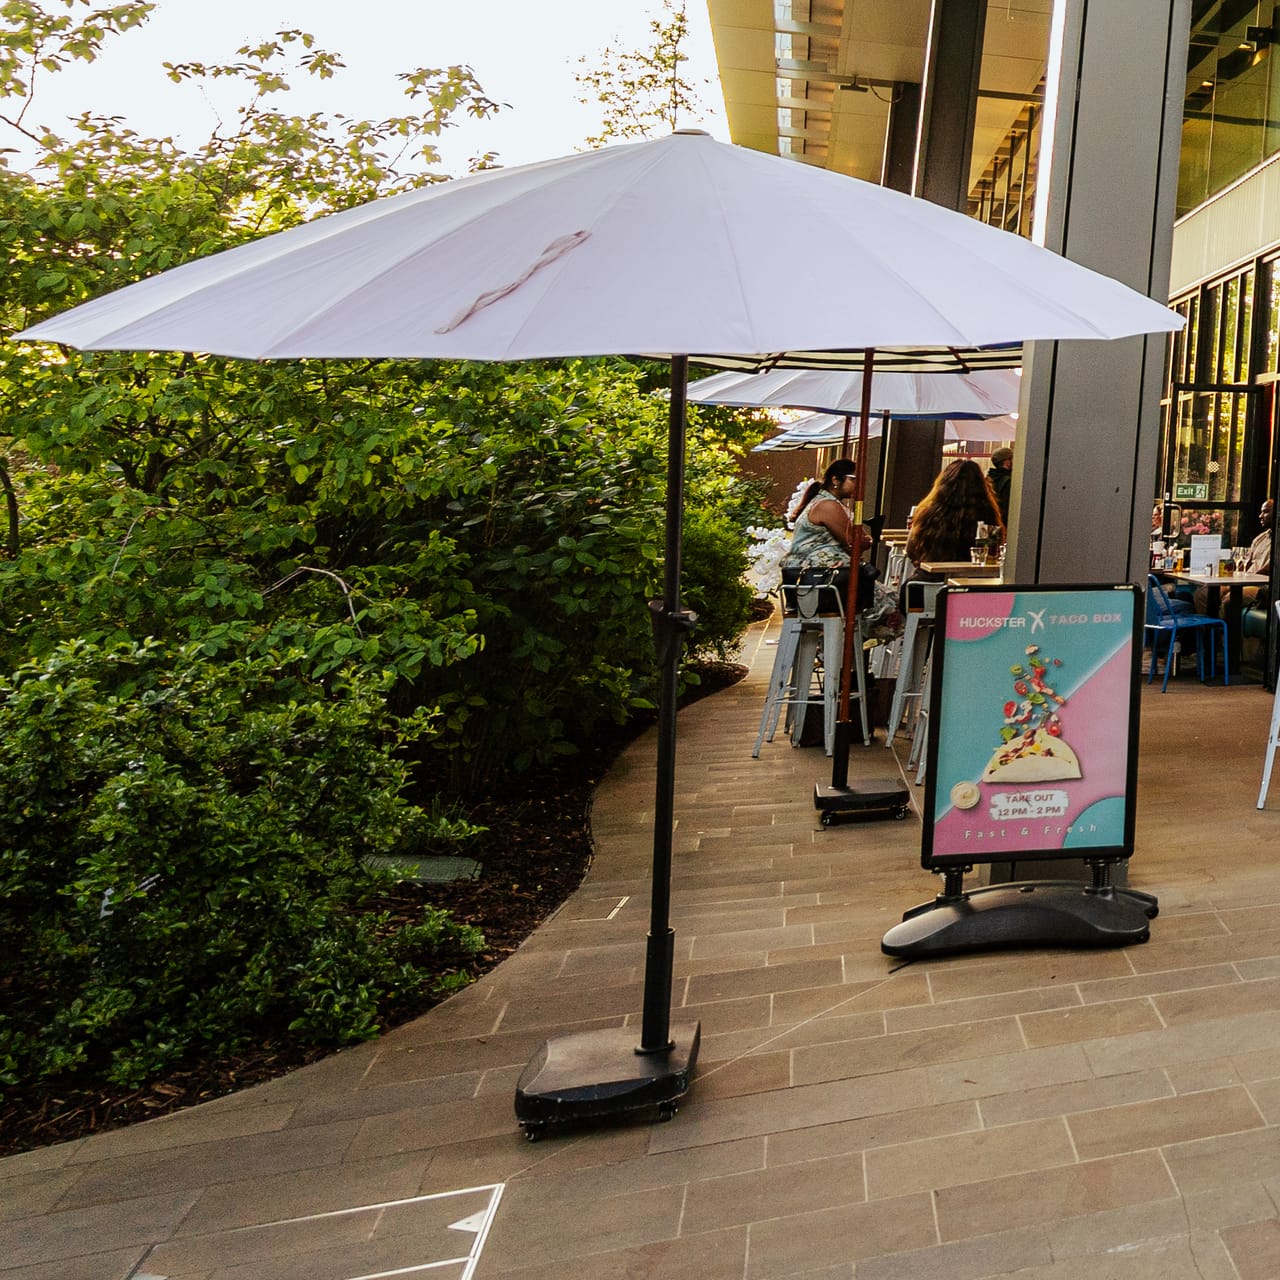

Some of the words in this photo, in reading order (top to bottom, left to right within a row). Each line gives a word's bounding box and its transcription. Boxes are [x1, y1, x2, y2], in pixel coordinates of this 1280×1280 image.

[1177, 487, 1194, 496] Exit
[959, 617, 1026, 629] HUCKSTER
[1034, 793, 1054, 803] OUT
[1012, 807, 1028, 816] PM
[1036, 806, 1043, 815] 2
[1045, 806, 1061, 815] PM
[964, 829, 1007, 839] Fast
[1020, 826, 1030, 836] &
[1044, 823, 1097, 834] Fresh
